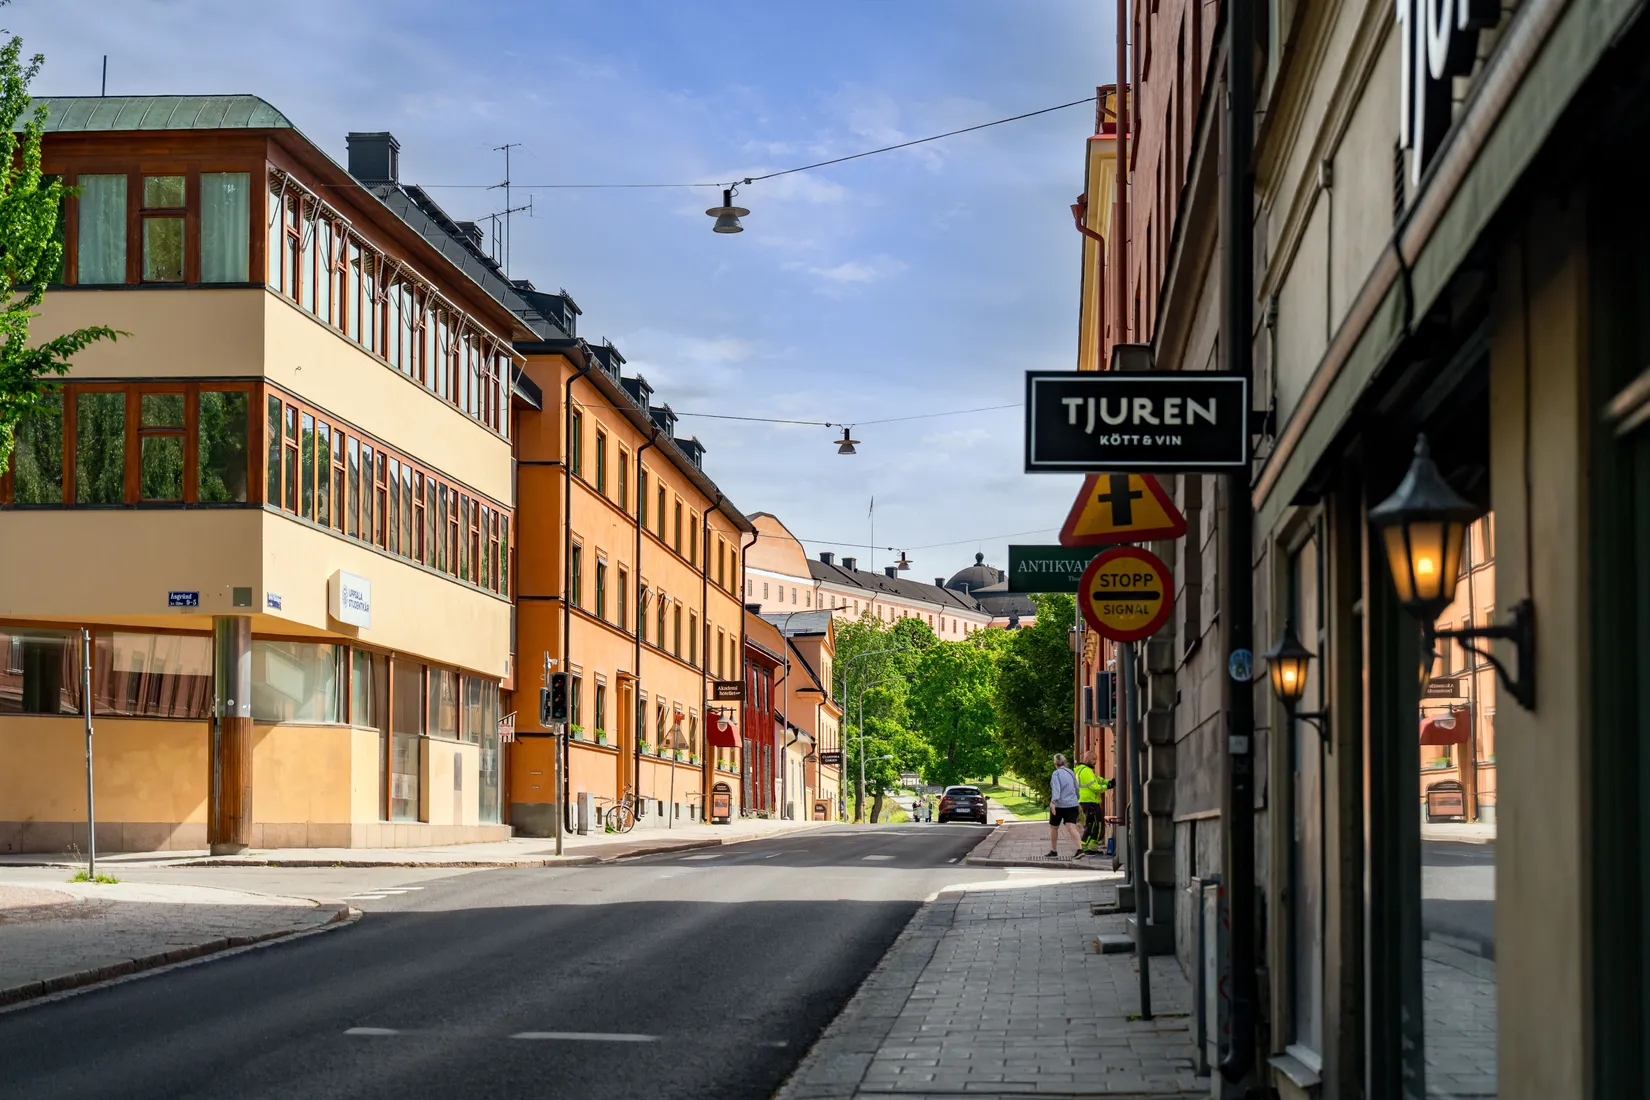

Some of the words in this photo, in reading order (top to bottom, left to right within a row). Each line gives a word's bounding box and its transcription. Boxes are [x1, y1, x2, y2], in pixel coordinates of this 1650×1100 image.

[1061, 397, 1217, 434] TJUREN
[1100, 433, 1140, 445] KÖTT
[1155, 435, 1182, 445] VIN
[1100, 573, 1153, 587] STOPP
[1103, 604, 1149, 615] SIGNAL
